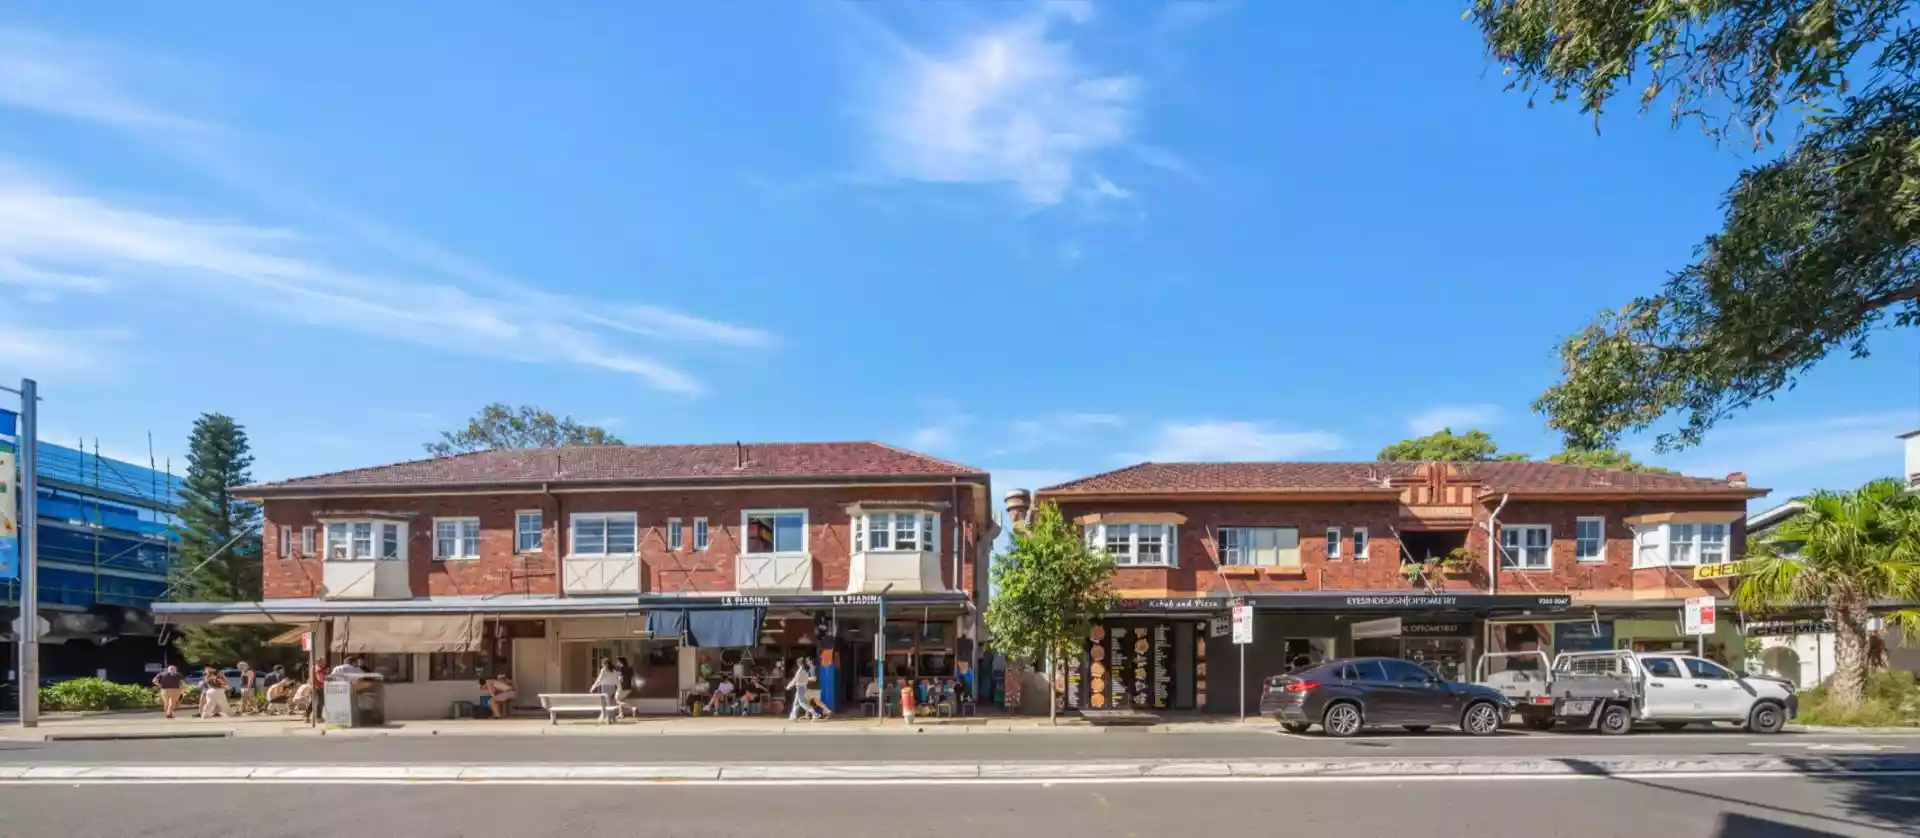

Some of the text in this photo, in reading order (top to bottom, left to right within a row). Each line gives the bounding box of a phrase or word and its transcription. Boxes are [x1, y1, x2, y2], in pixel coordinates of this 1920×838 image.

[721, 596, 732, 606] LA
[833, 596, 844, 605] LA
[1176, 599, 1192, 607] and
[1194, 599, 1219, 608] Pizza
